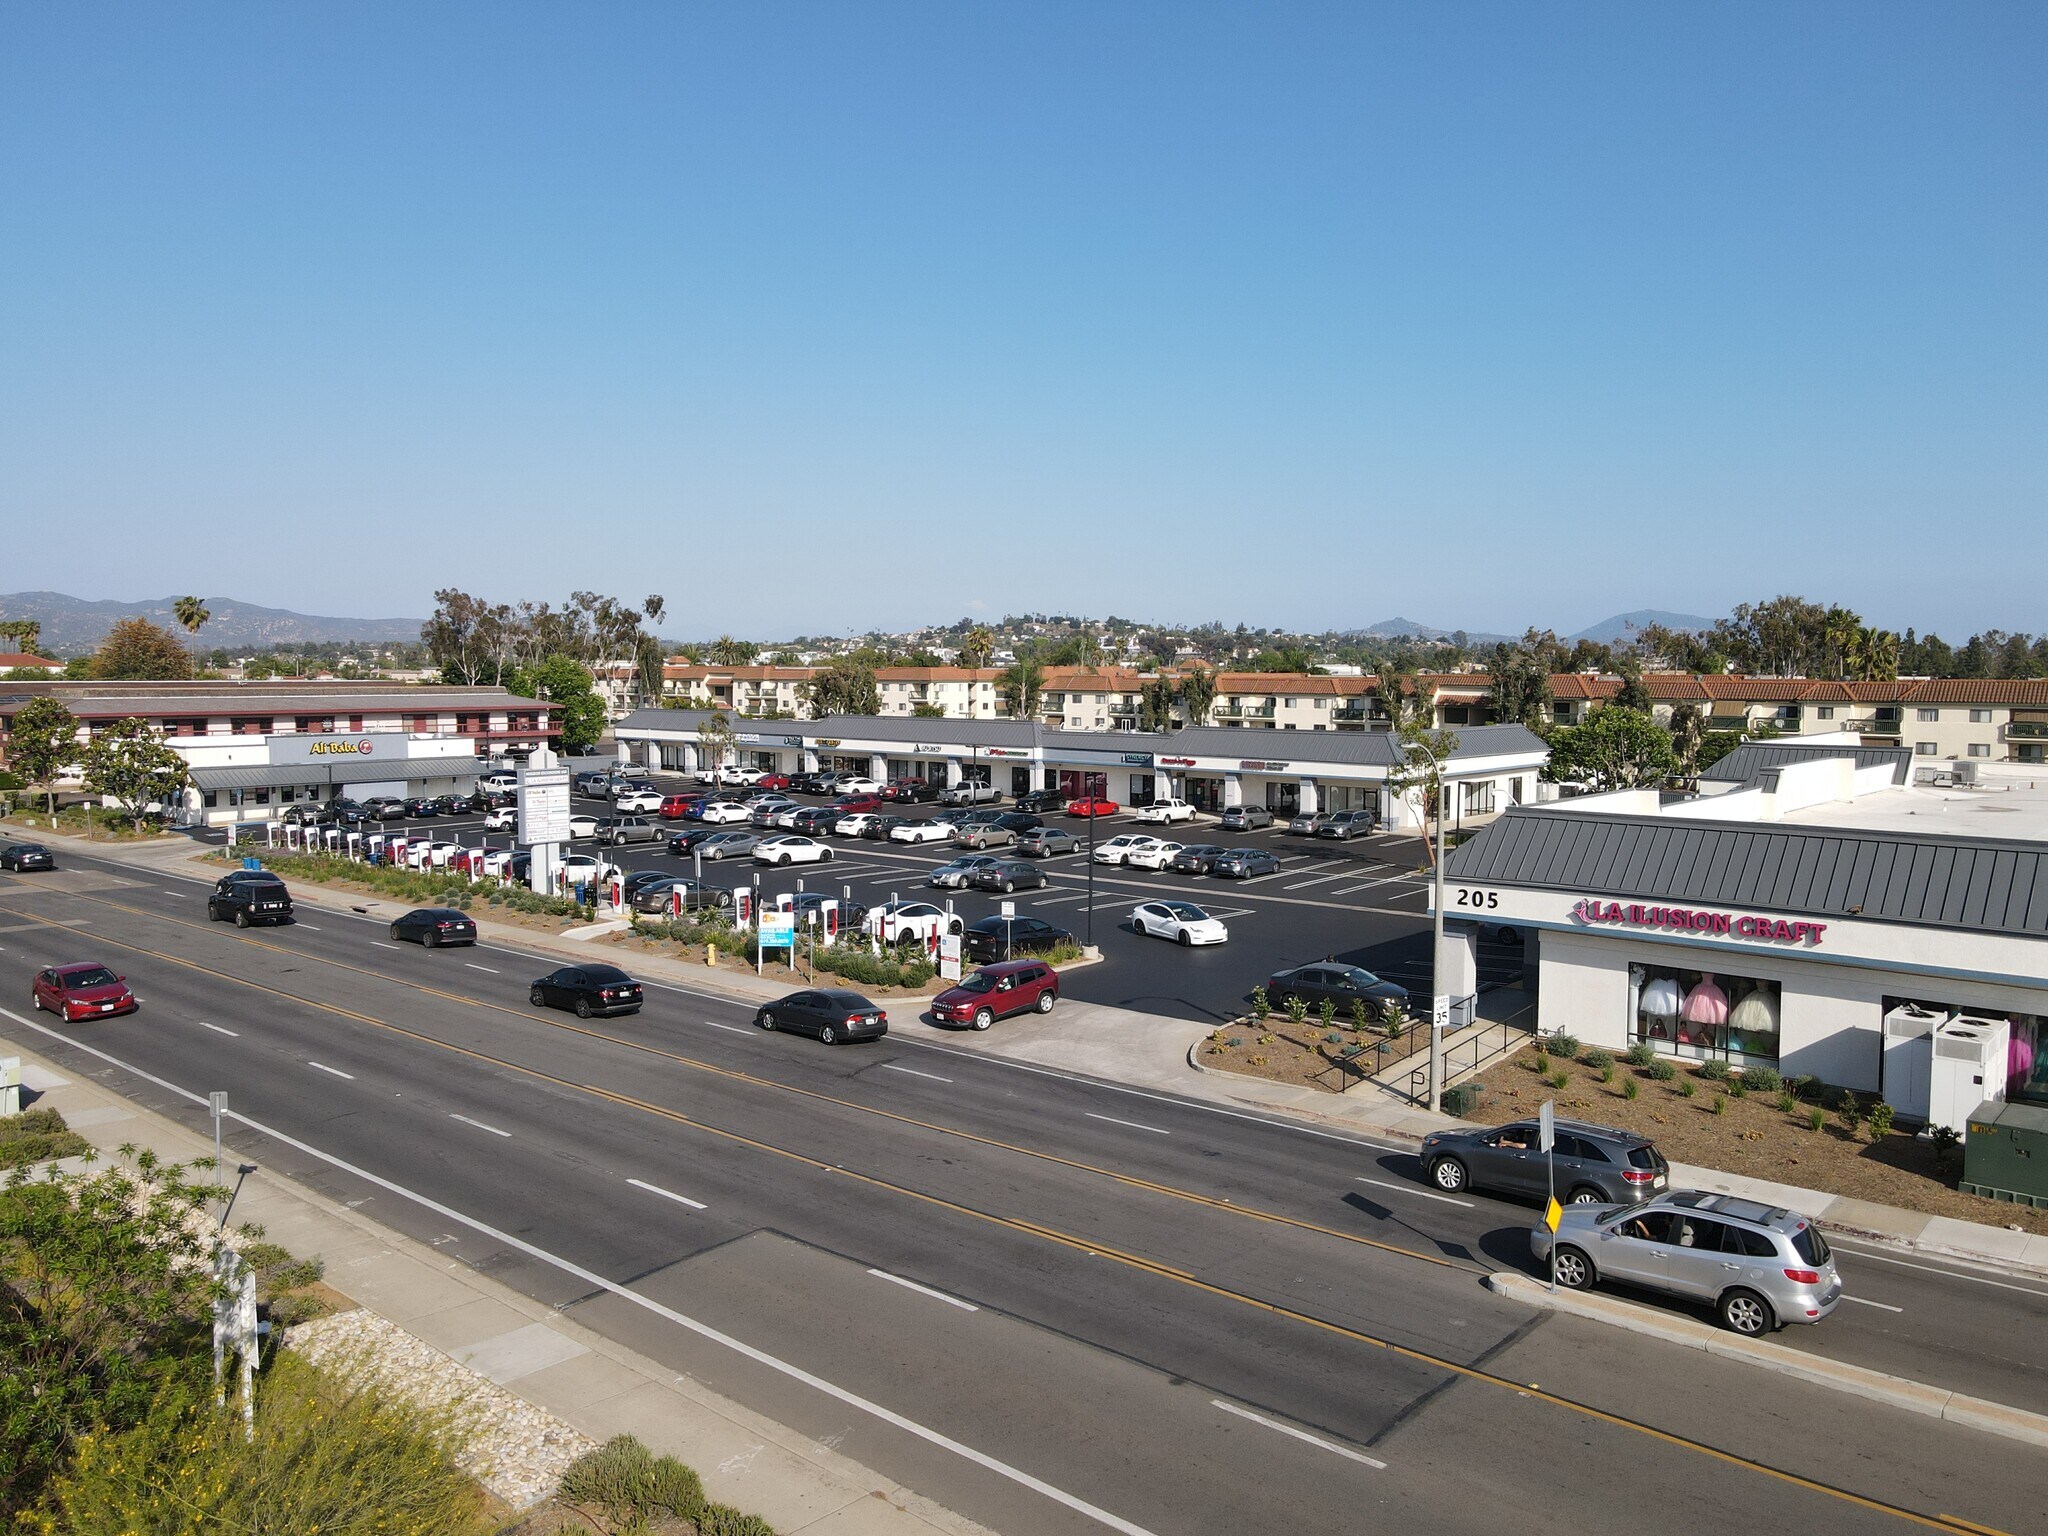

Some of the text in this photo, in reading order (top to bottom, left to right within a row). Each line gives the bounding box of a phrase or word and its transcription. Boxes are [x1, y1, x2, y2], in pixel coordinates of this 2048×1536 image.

[311, 741, 358, 754] Ali Baba
[1457, 889, 1499, 909] 205
[1593, 901, 1827, 944] LA ILUSION CRAFT
[1436, 1011, 1448, 1024] 35
